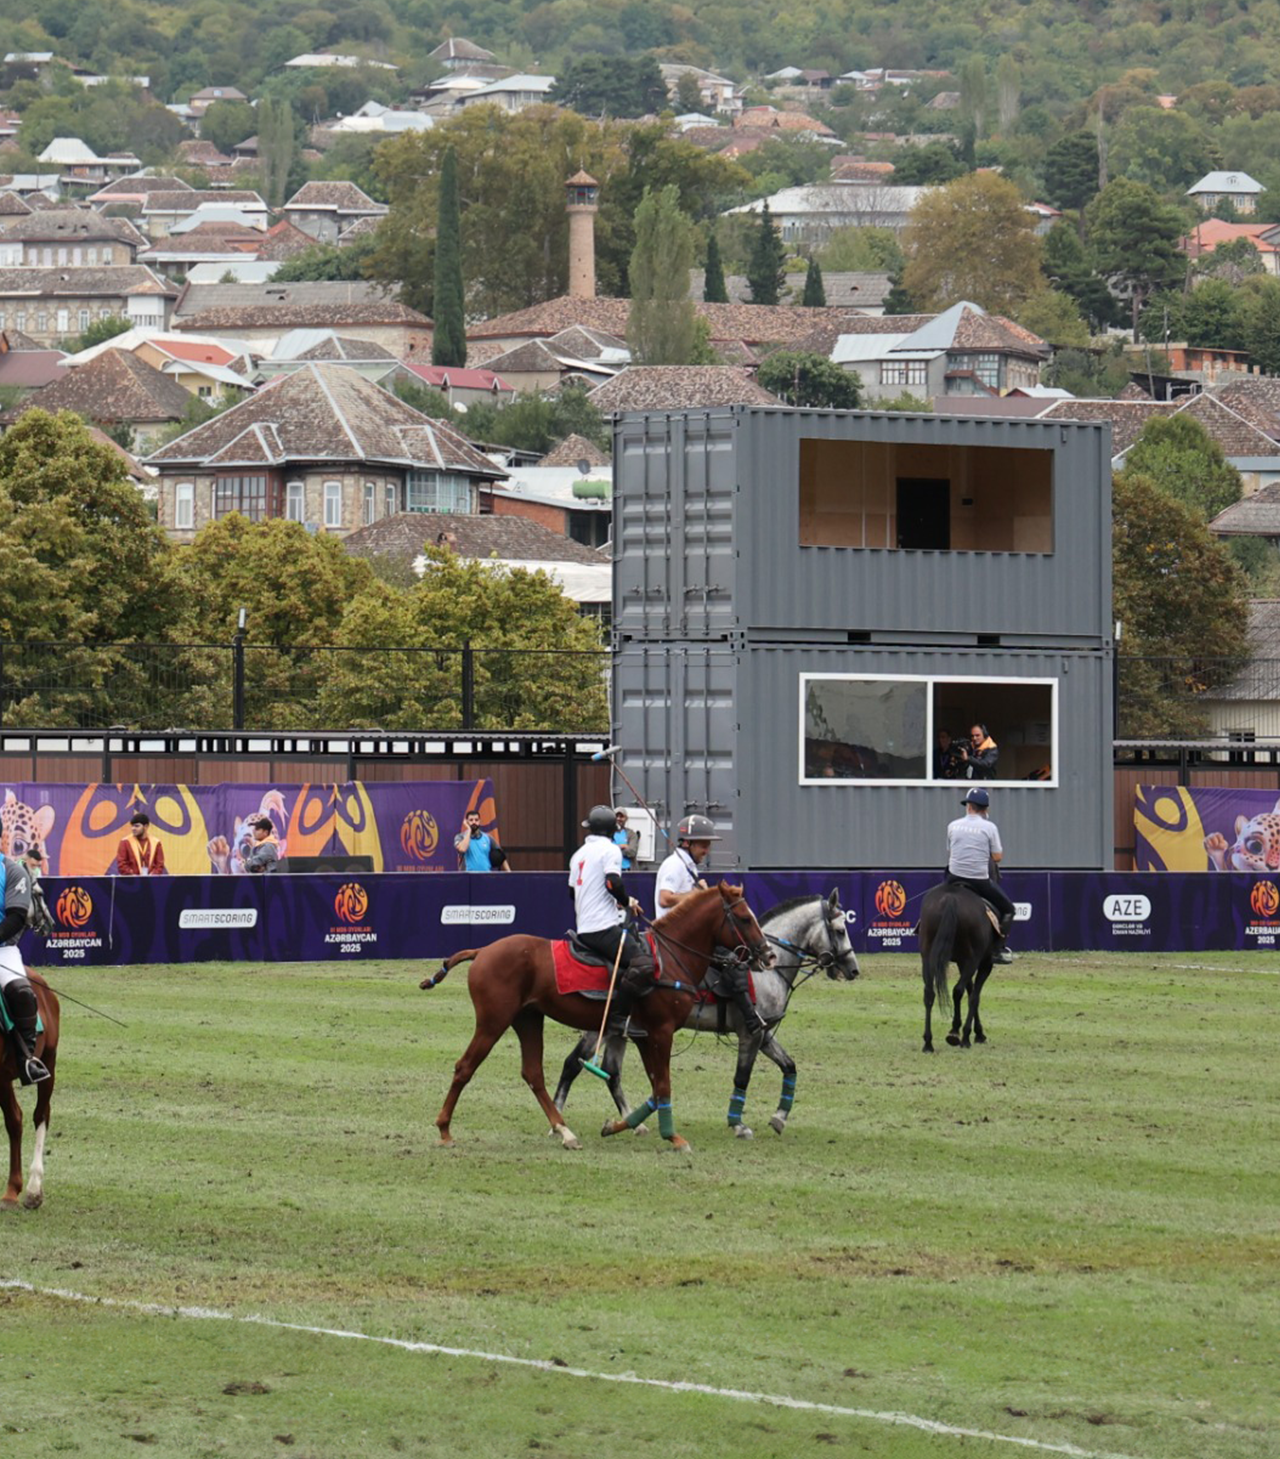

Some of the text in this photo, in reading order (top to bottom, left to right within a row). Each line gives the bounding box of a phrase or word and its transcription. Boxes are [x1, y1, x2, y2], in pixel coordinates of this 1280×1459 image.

[577, 860, 585, 886] 1
[15, 877, 27, 894] 4
[1112, 900, 1142, 916] AZE
[46, 938, 102, 948] AZƏRBAYCAN
[324, 933, 377, 943] AZƏRBAYCAN
[882, 938, 902, 946] 2025
[1257, 936, 1275, 944] 2025
[340, 943, 362, 952] 2025
[63, 949, 85, 958] 2025
